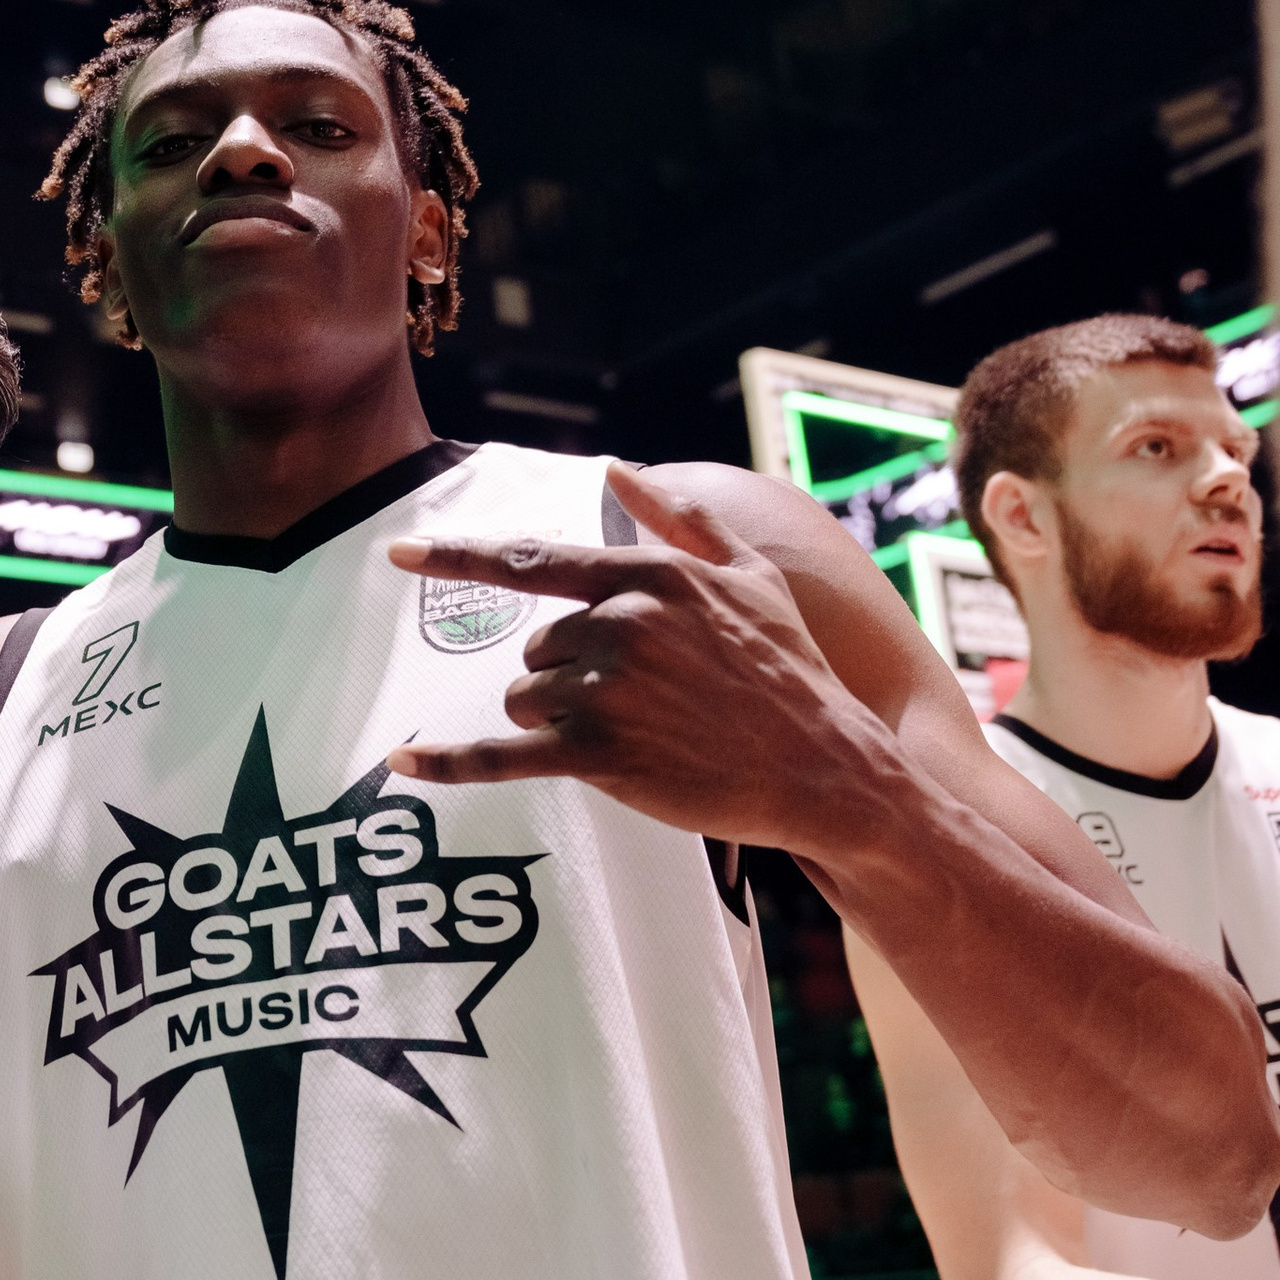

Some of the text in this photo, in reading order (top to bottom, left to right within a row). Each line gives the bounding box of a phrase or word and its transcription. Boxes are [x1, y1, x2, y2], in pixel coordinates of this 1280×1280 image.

[423, 593, 527, 622] BASKET
[424, 586, 518, 610] MEDI
[72, 620, 140, 707] 7
[37, 682, 162, 747] MEXC
[105, 808, 423, 930] GOATS
[60, 873, 523, 1038] ALLSTARS
[168, 984, 361, 1052] MUSIC
